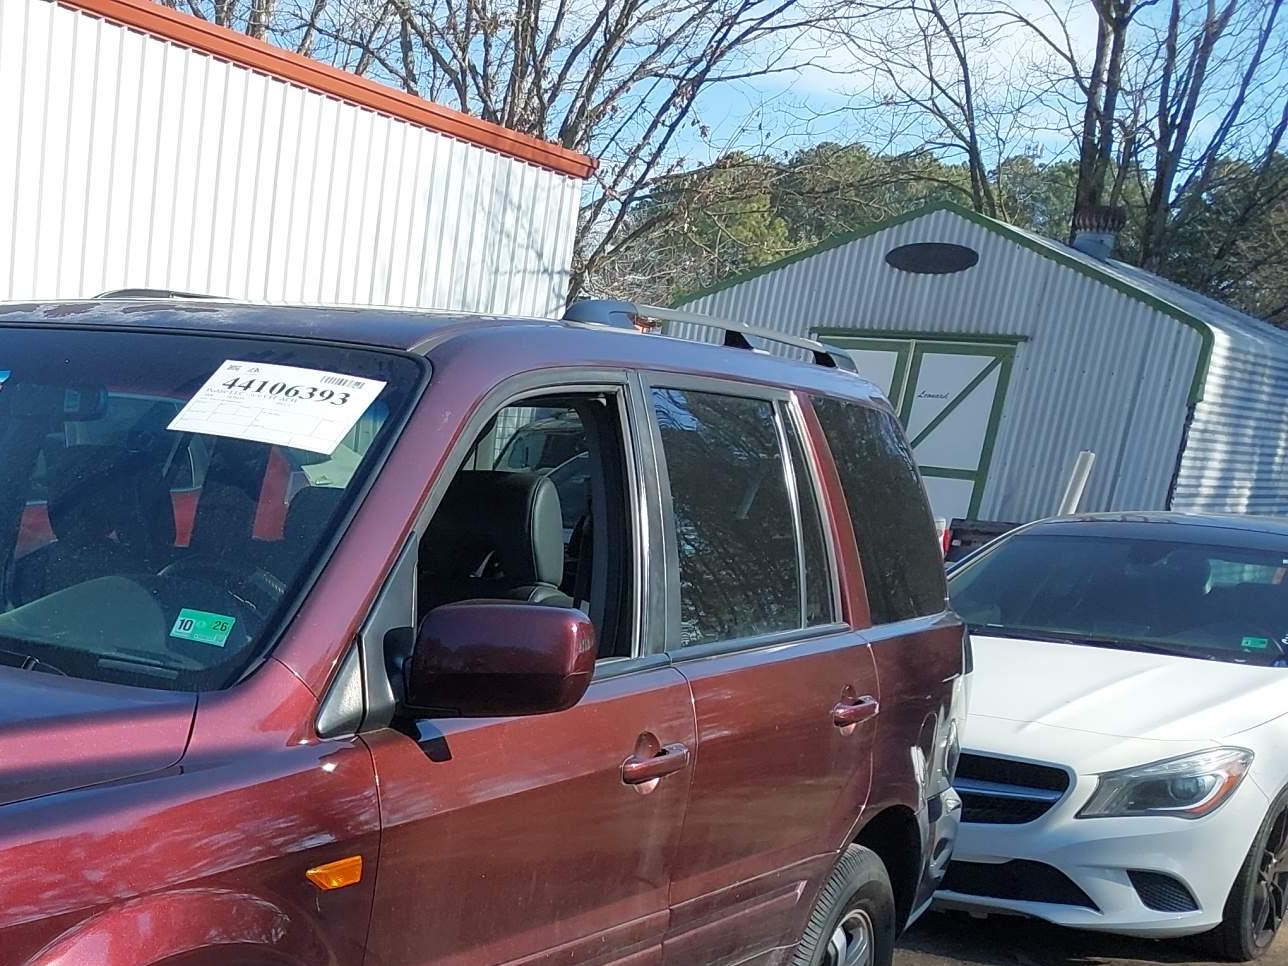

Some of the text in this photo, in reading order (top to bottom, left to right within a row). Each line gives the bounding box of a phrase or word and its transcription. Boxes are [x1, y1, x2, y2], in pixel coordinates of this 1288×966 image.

[222, 377, 351, 406] 44106393
[178, 619, 229, 632] 10 26
